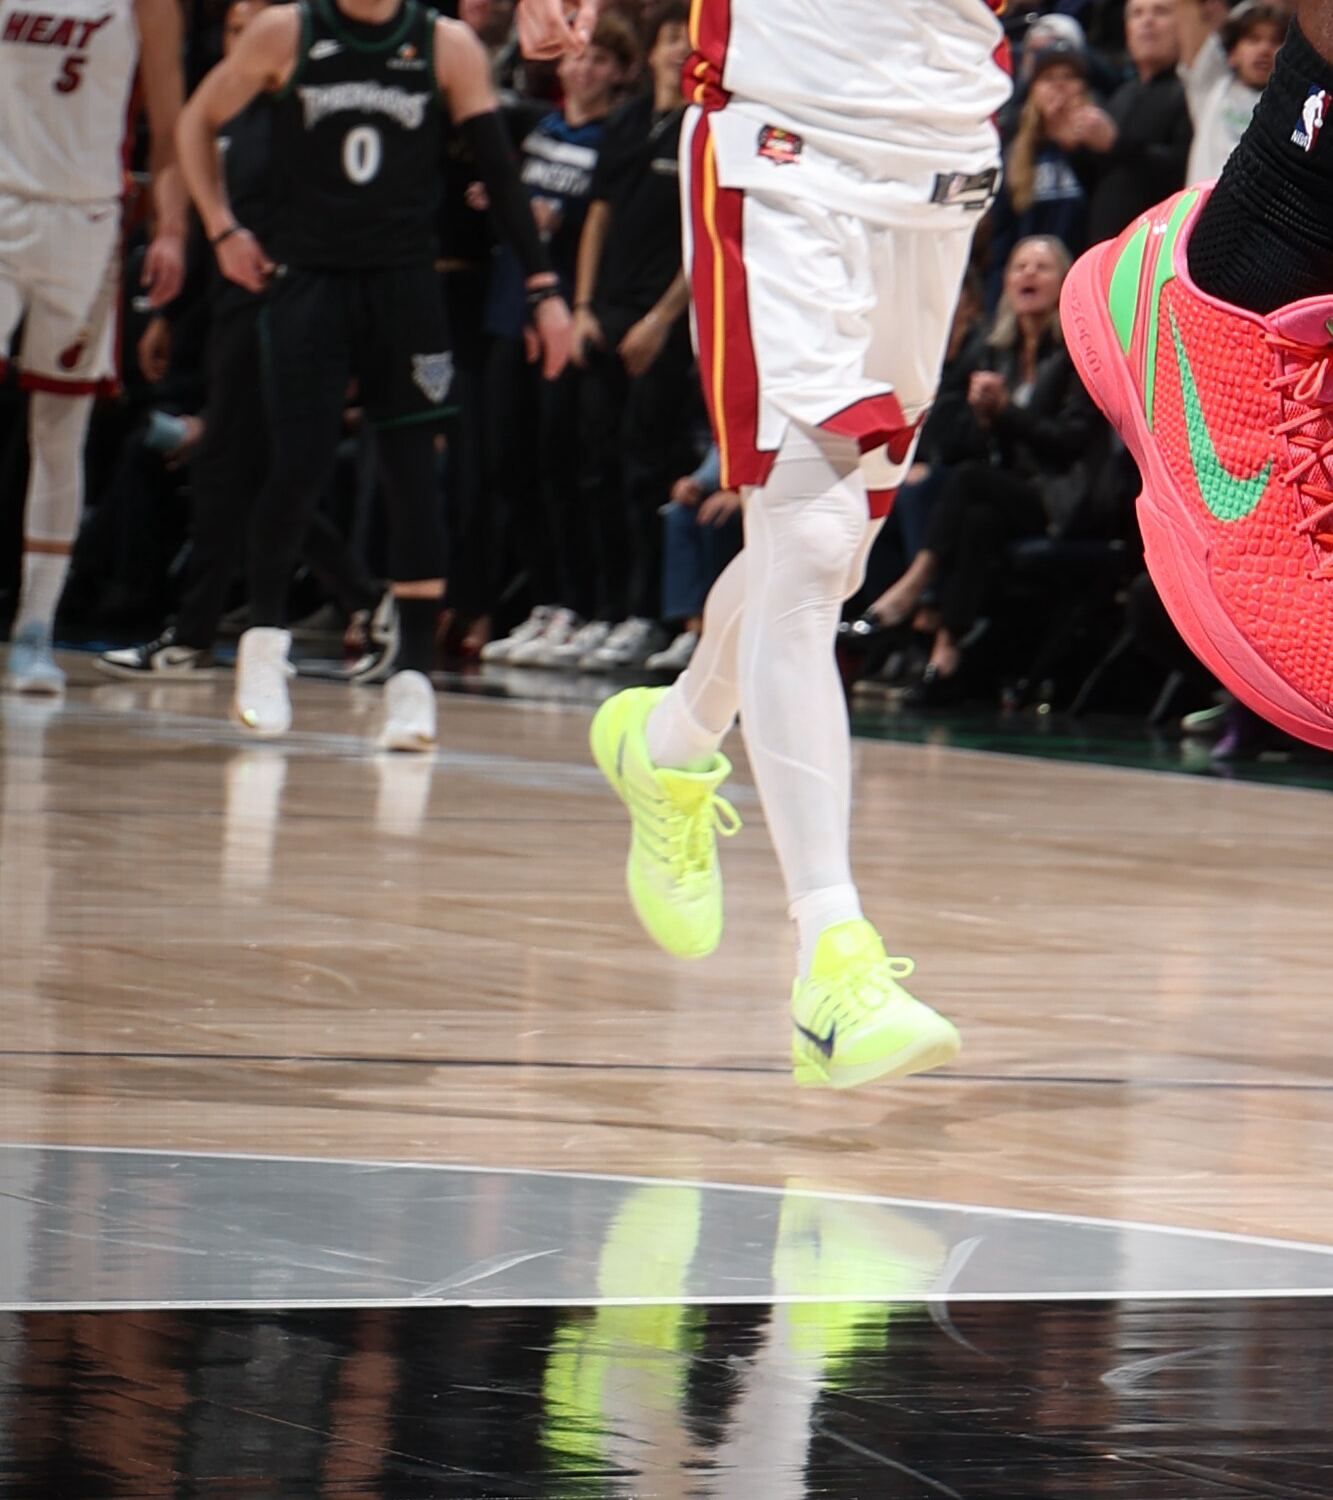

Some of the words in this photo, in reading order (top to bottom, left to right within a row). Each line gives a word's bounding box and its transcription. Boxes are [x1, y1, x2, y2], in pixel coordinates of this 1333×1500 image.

[2, 11, 113, 49] HEAT
[55, 55, 88, 94] 5
[342, 122, 384, 186] 0
